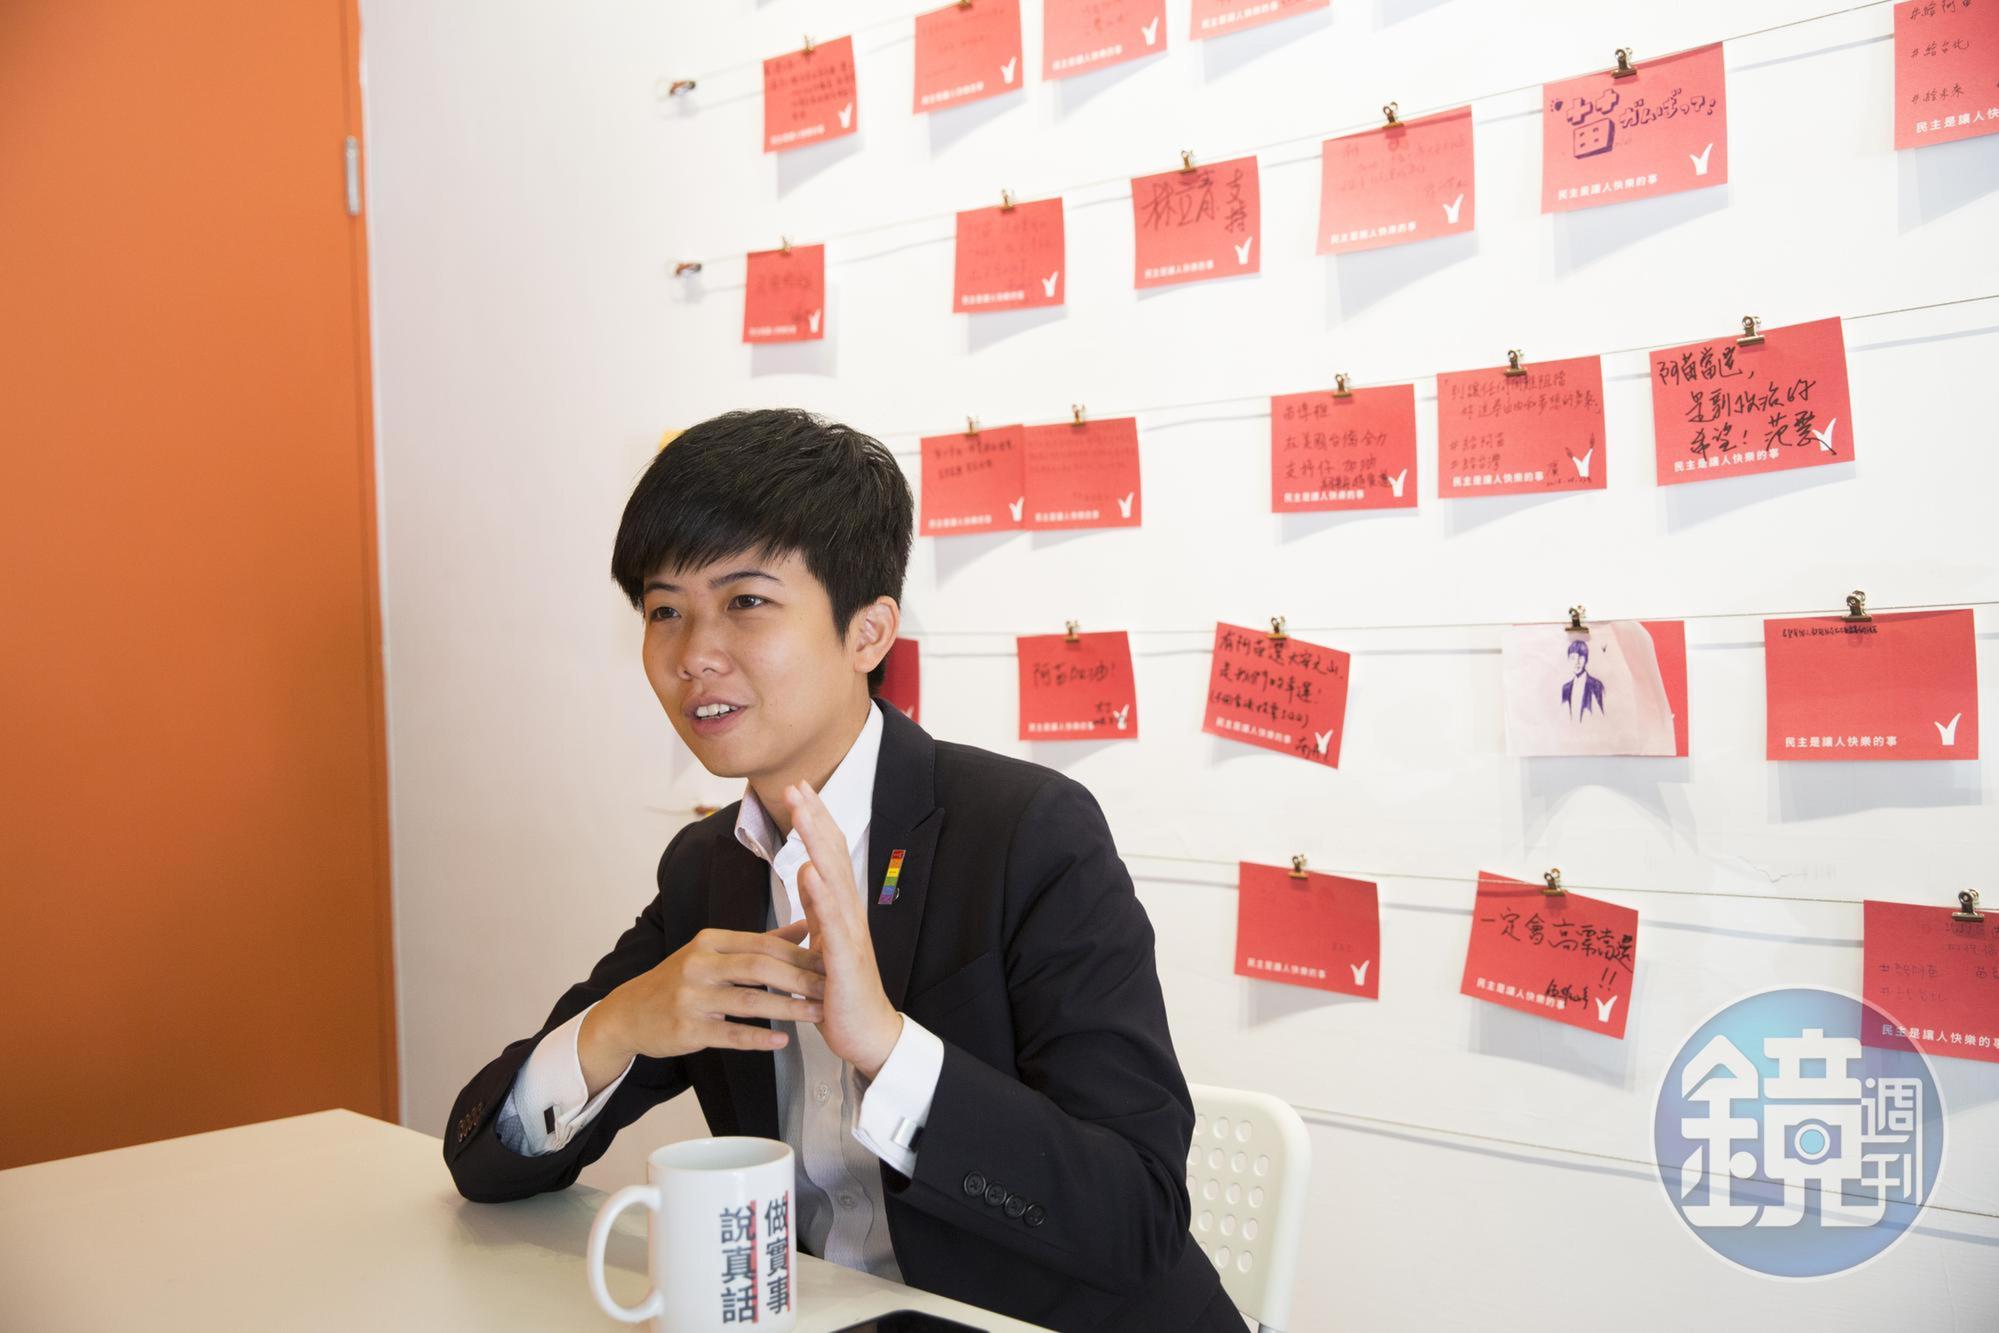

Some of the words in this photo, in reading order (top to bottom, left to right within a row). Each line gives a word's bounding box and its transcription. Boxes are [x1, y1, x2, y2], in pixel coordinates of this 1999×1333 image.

[1558, 173, 1658, 200] 民主是讓人快樂的事
[1674, 447, 1780, 473] 民主是讓人快樂的事
[1785, 735, 1898, 749] 民主是讓人快樂的事
[719, 1205, 757, 1324] 說真話
[764, 1198, 789, 1316] 做實事
